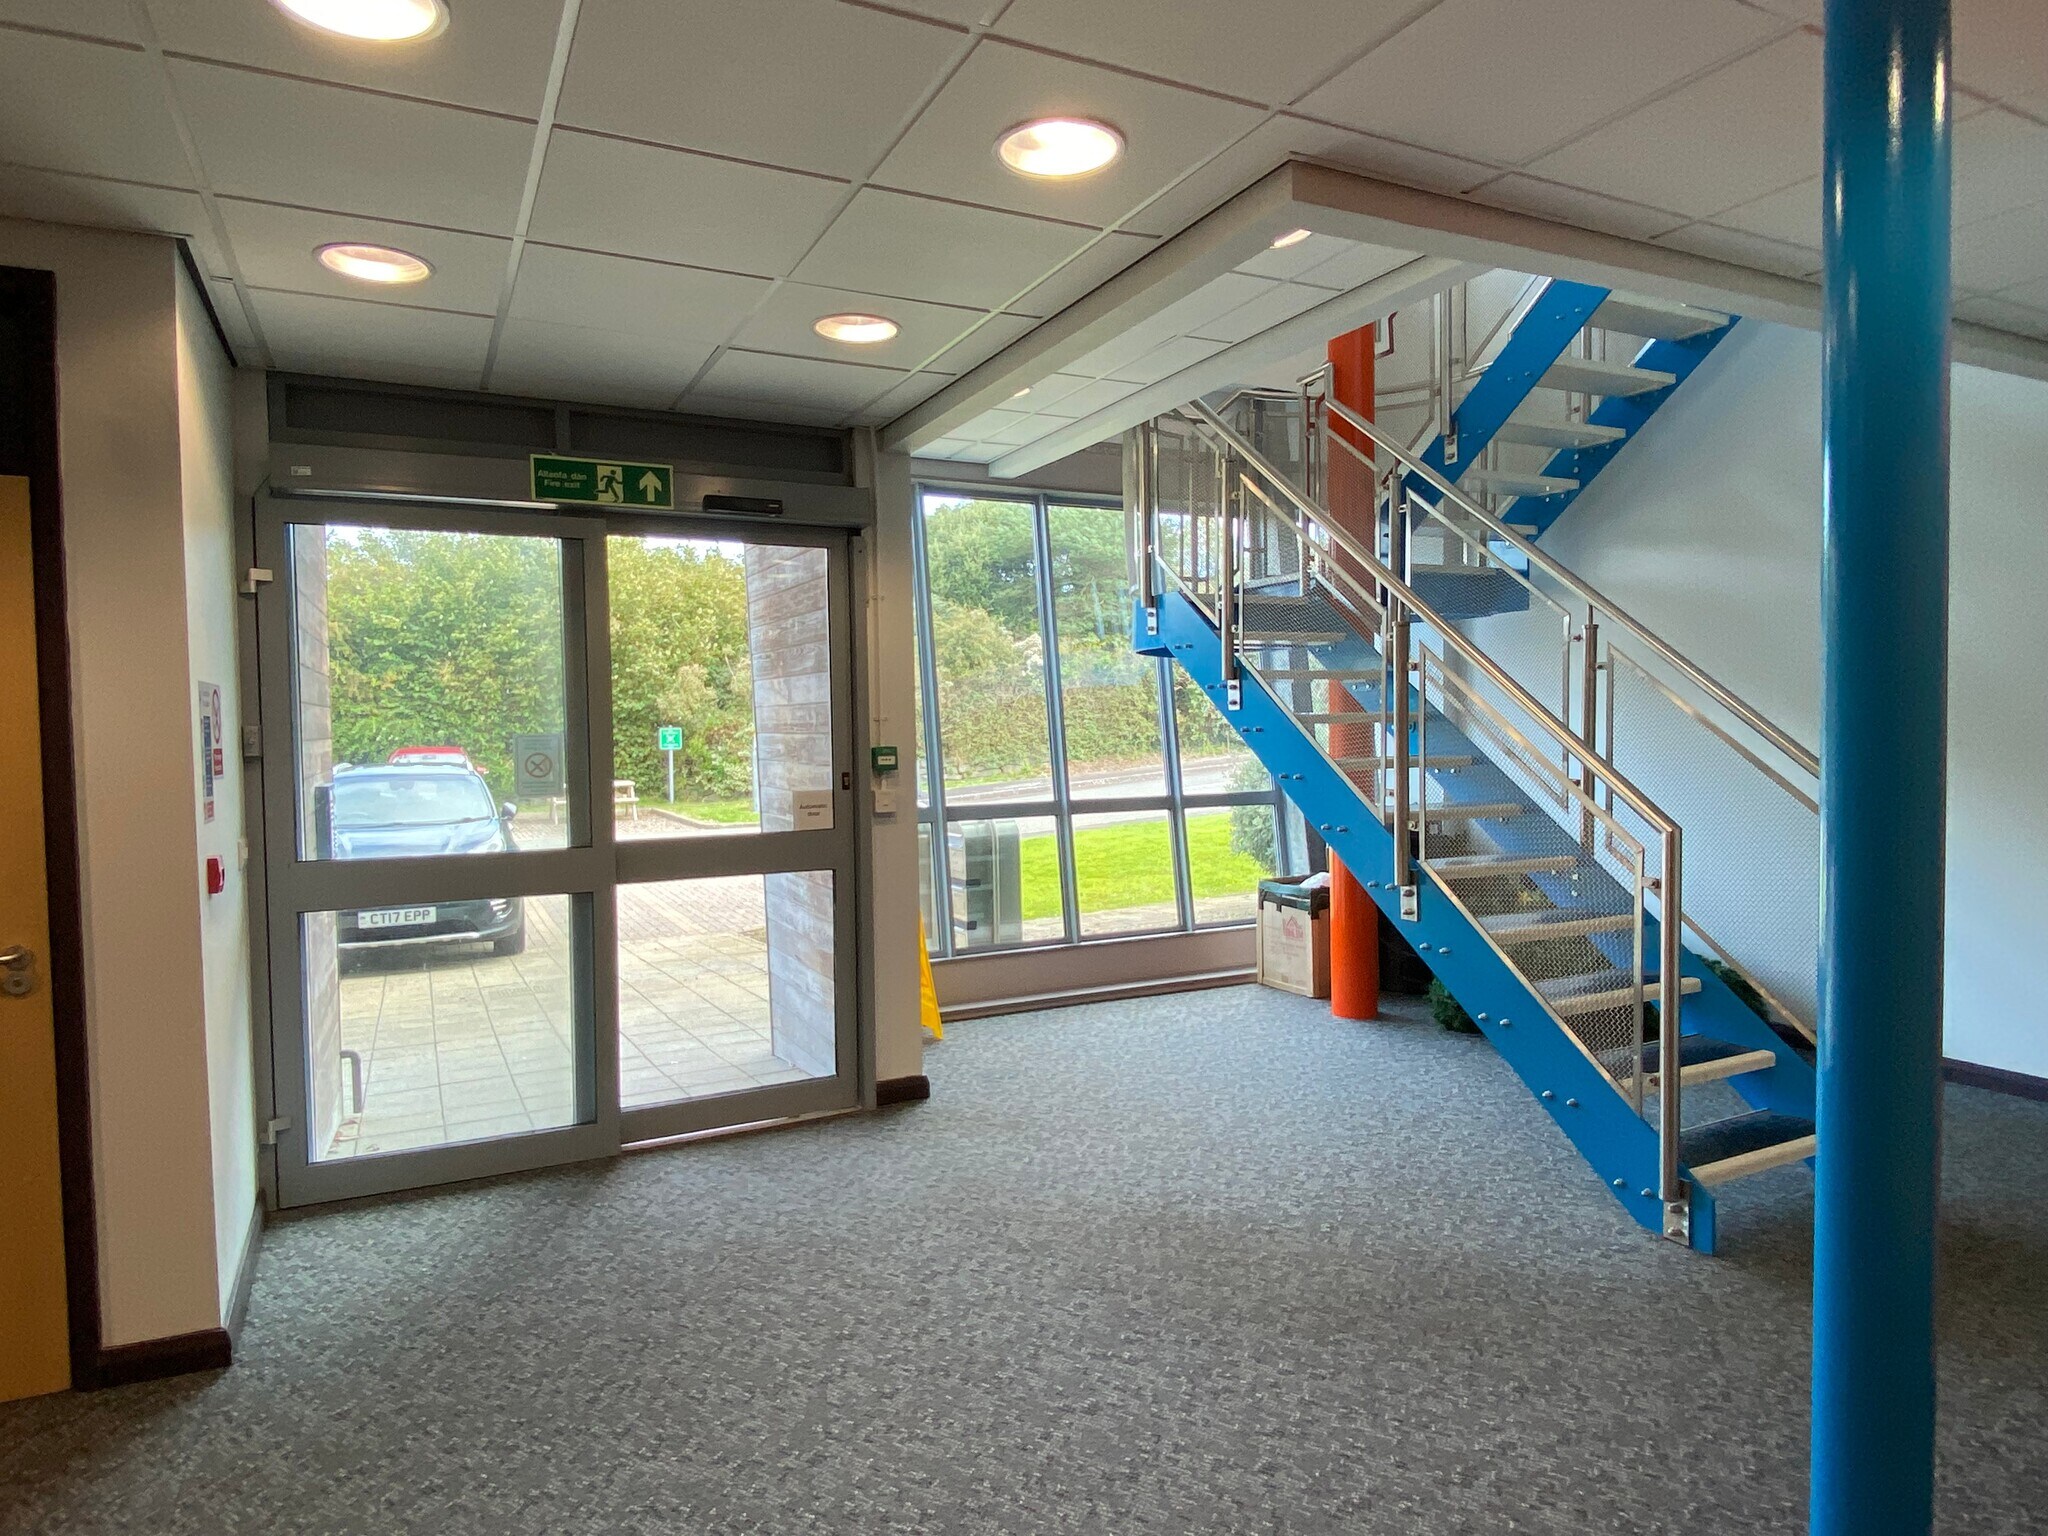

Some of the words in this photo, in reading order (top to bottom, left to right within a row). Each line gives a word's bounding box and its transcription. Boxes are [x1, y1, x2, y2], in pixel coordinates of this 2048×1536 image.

[544, 479, 560, 487] Fire
[370, 912, 400, 924] CT17
[404, 909, 431, 922] EPP
